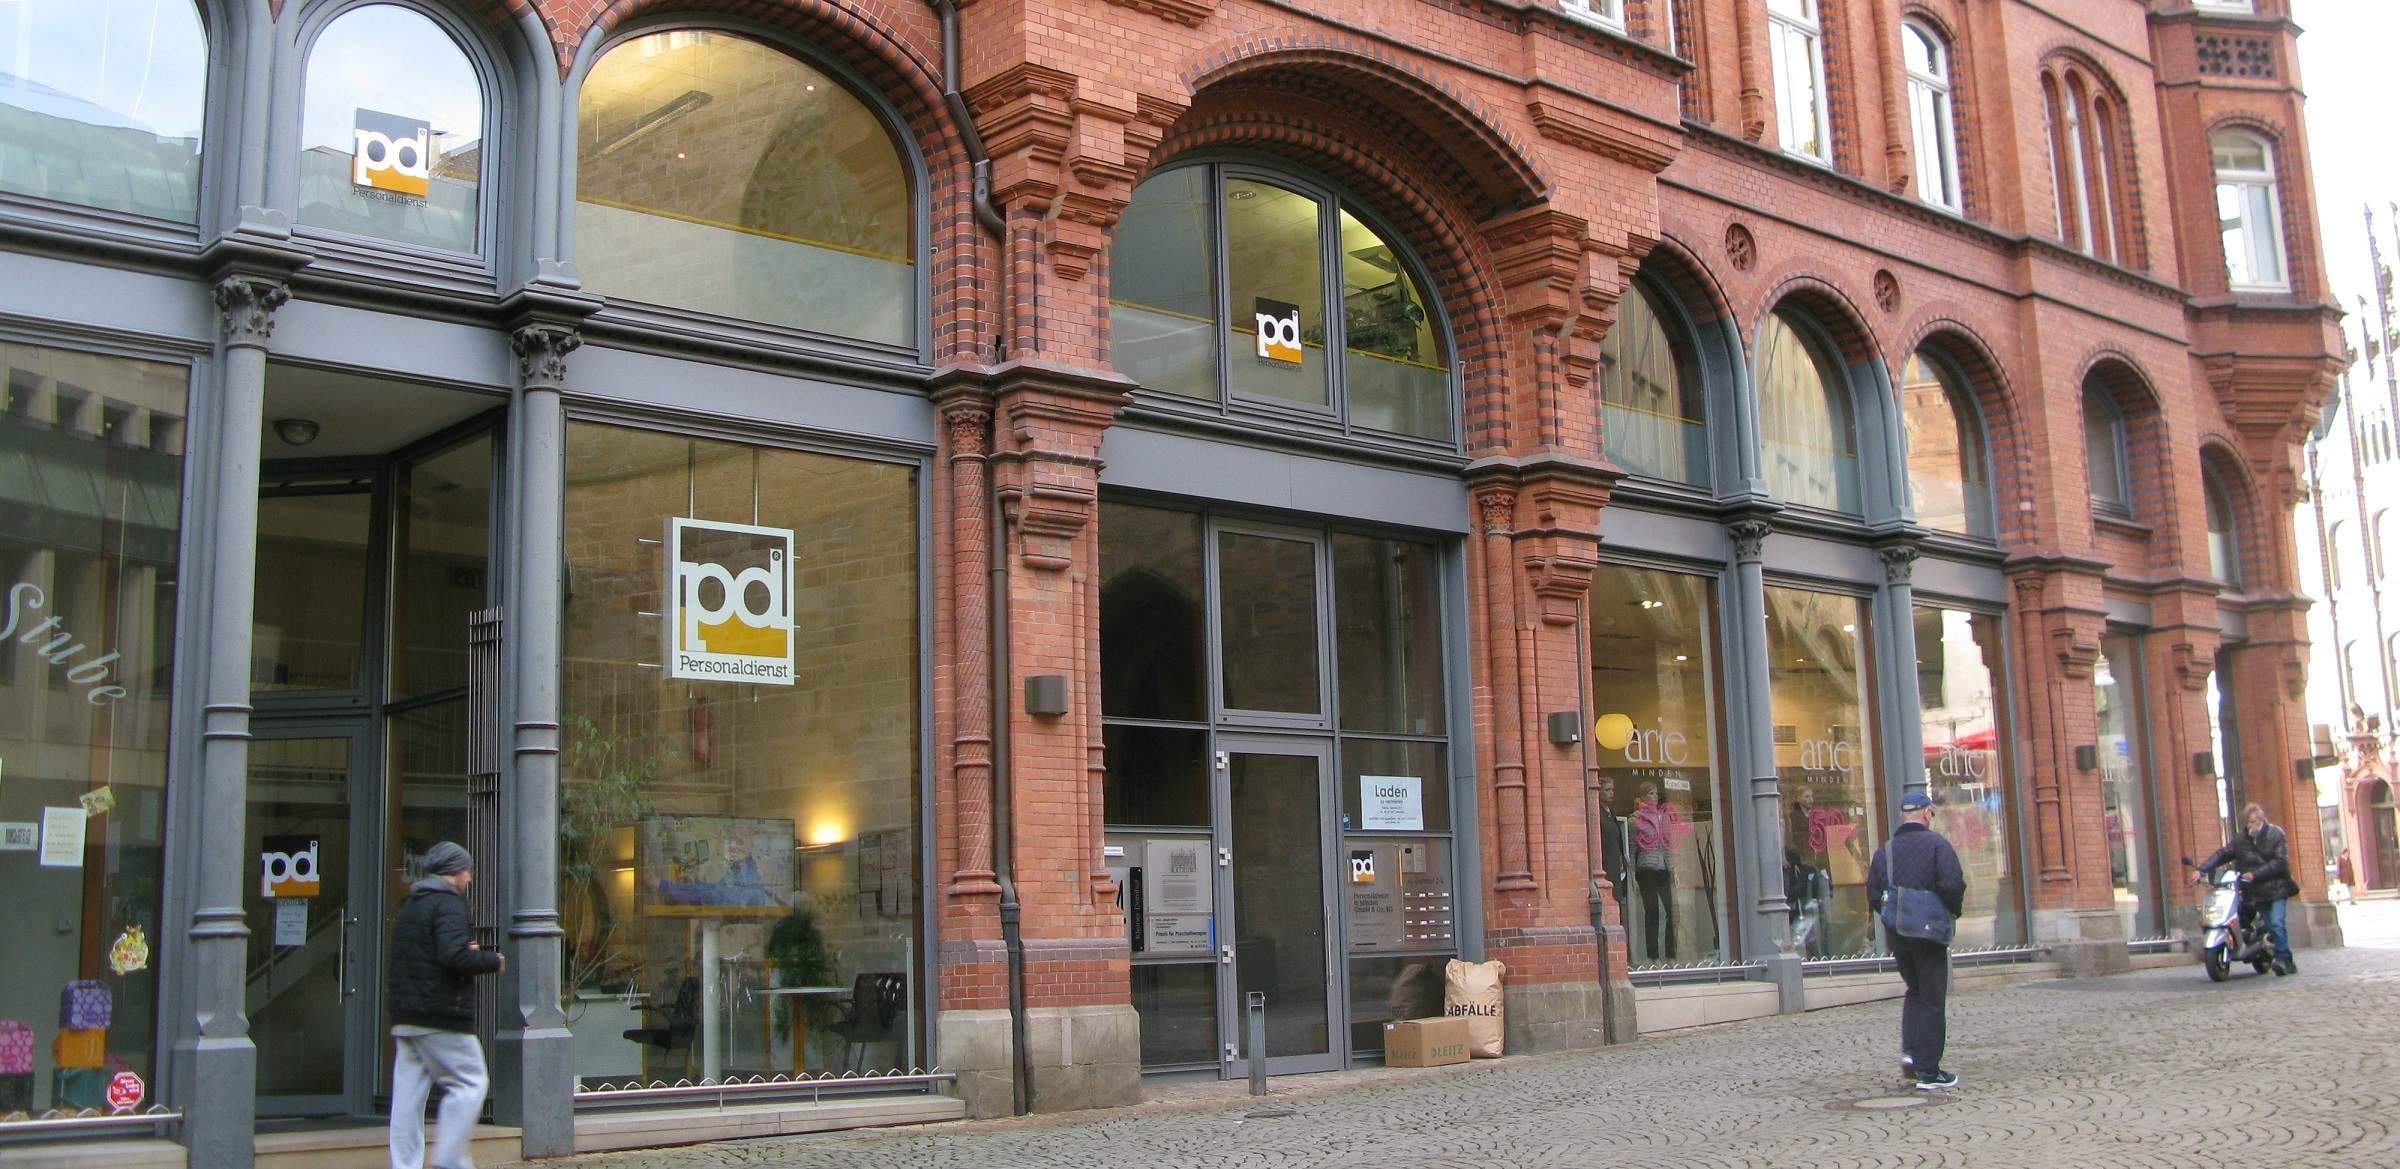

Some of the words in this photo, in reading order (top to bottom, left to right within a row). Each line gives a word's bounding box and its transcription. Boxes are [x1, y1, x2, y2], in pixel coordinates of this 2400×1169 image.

[355, 128, 430, 186] pd
[353, 186, 429, 209] Personaldienst
[1255, 310, 1302, 358] pd
[680, 548, 788, 652] pd
[0, 582, 127, 706] Stube
[679, 655, 789, 678] Personaldienst
[1624, 716, 1689, 765] arie
[1800, 727, 1853, 773] arie
[1631, 768, 1682, 777] MINDEN
[1375, 785, 1408, 798] Laden
[262, 840, 320, 898] pd
[1352, 853, 1375, 882] pd
[1447, 1001, 1497, 1017] ABFÄLLE
[1396, 1050, 1418, 1059] LEITZ
[1437, 1044, 1464, 1056] LEITZ
